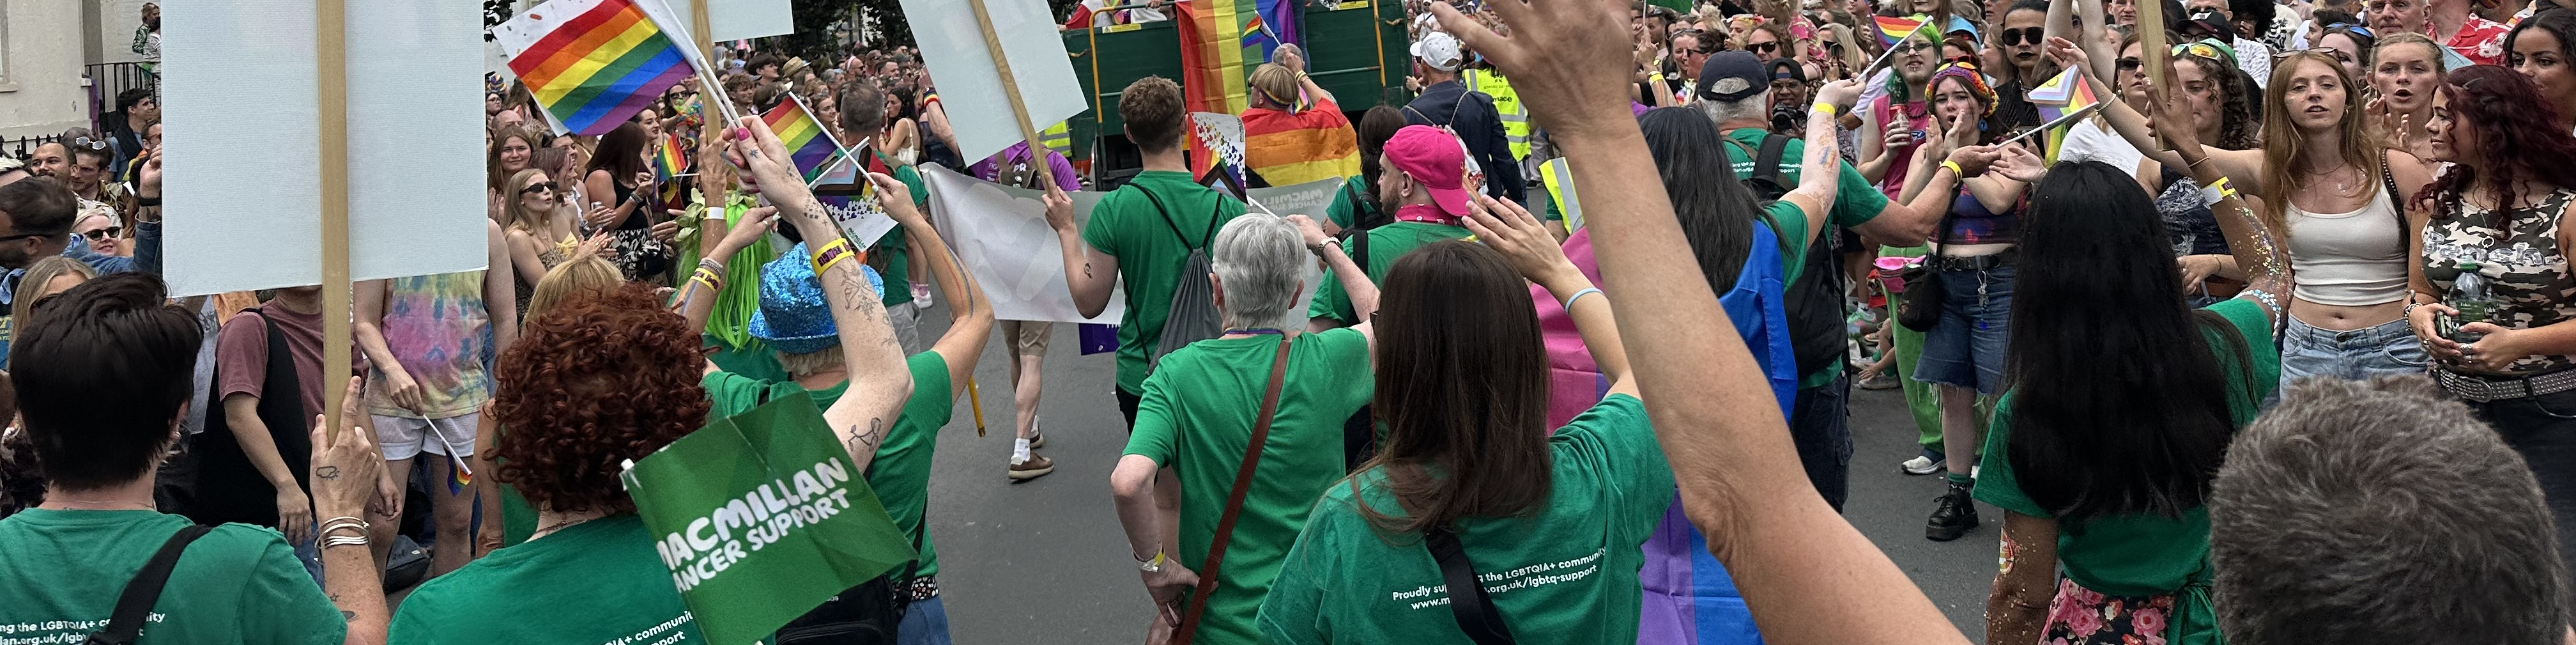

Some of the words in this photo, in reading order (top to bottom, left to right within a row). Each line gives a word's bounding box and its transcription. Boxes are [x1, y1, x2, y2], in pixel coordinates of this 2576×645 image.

[673, 540, 747, 593] ANCER
[746, 488, 850, 550] SUPPORT
[1393, 585, 1431, 600] Proudly
[1485, 572, 1503, 582] the
[1505, 563, 1556, 579] LGBTQIA+
[1558, 546, 1606, 569] community
[17, 622, 37, 632] the
[40, 620, 96, 630] LGBTQIA+
[635, 610, 693, 641] communit
